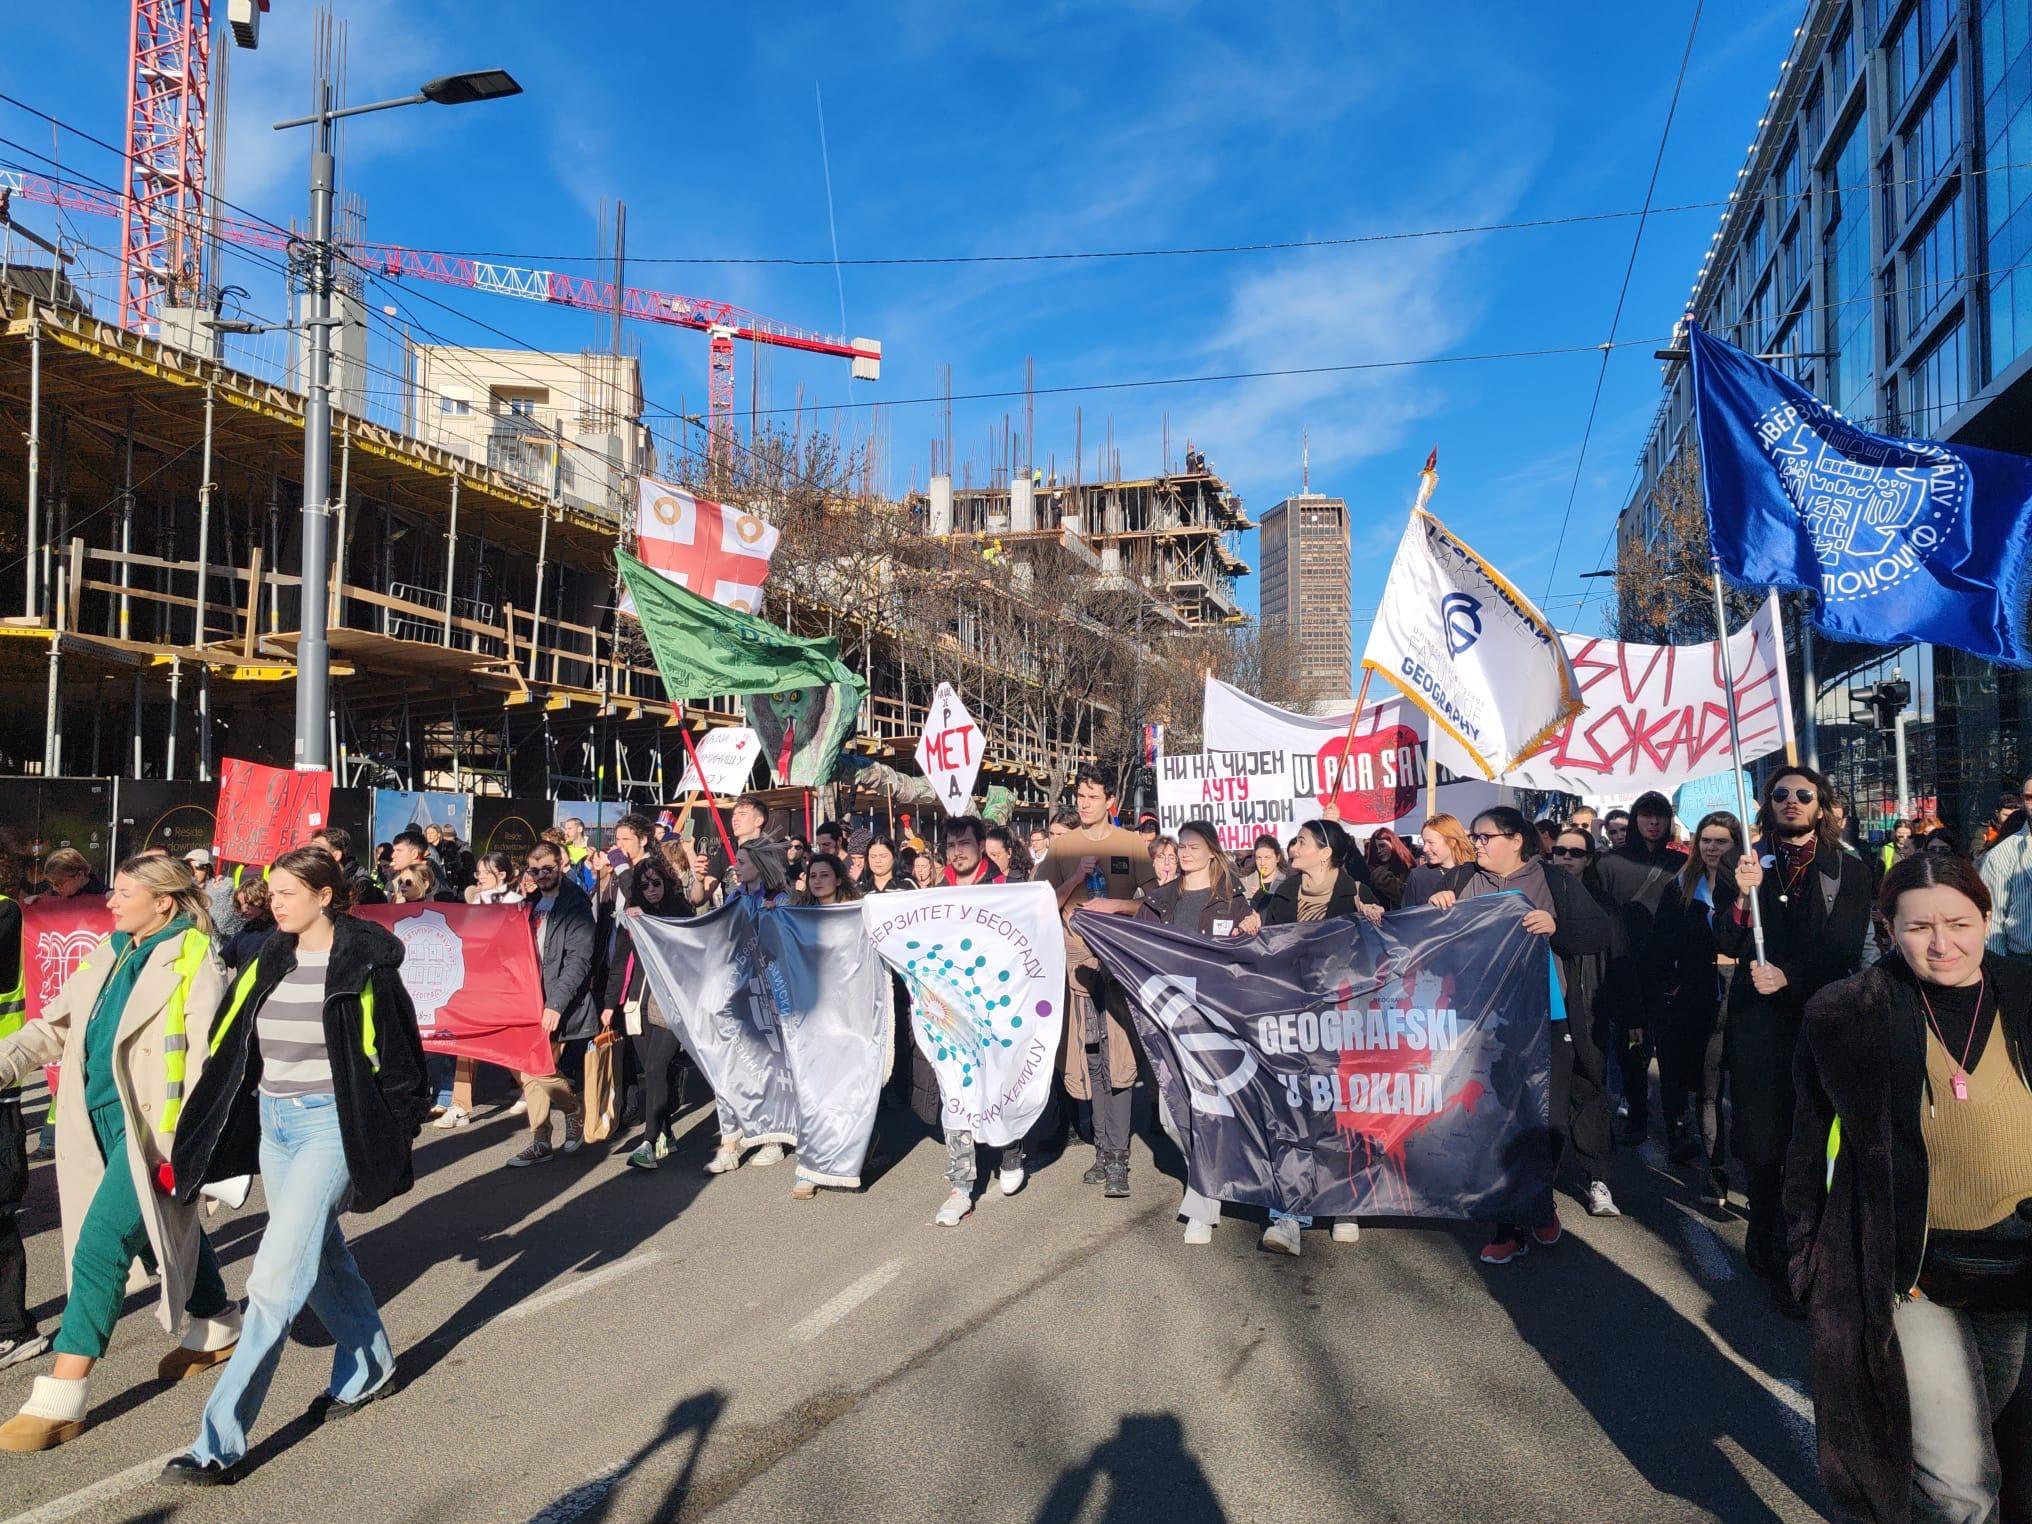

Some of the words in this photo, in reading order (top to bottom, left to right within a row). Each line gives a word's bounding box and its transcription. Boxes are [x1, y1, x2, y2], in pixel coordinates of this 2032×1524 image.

[1713, 630, 1760, 690] U
[1401, 656, 1480, 741] GEOGRAPHY
[925, 724, 974, 775] МЕТ
[1163, 756, 1188, 780] НИ
[1192, 755, 1217, 779] НА
[1222, 750, 1285, 777] ЧИЈЕМ
[1160, 804, 1185, 828] НИ
[1190, 802, 1227, 826] ПОД
[1231, 798, 1294, 824] ЧИЈОМ
[1202, 777, 1249, 802] АУТУ
[1217, 824, 1279, 850] АНДОМ
[959, 905, 973, 920] У
[976, 908, 1046, 980] БЕОГРАДУ
[1257, 1008, 1458, 1056] GEOGRAFSKI
[1003, 1037, 1046, 1106] ХЕМИЈУ
[1277, 1073, 1303, 1108] U
[1309, 1071, 1444, 1116] BLOKADI
